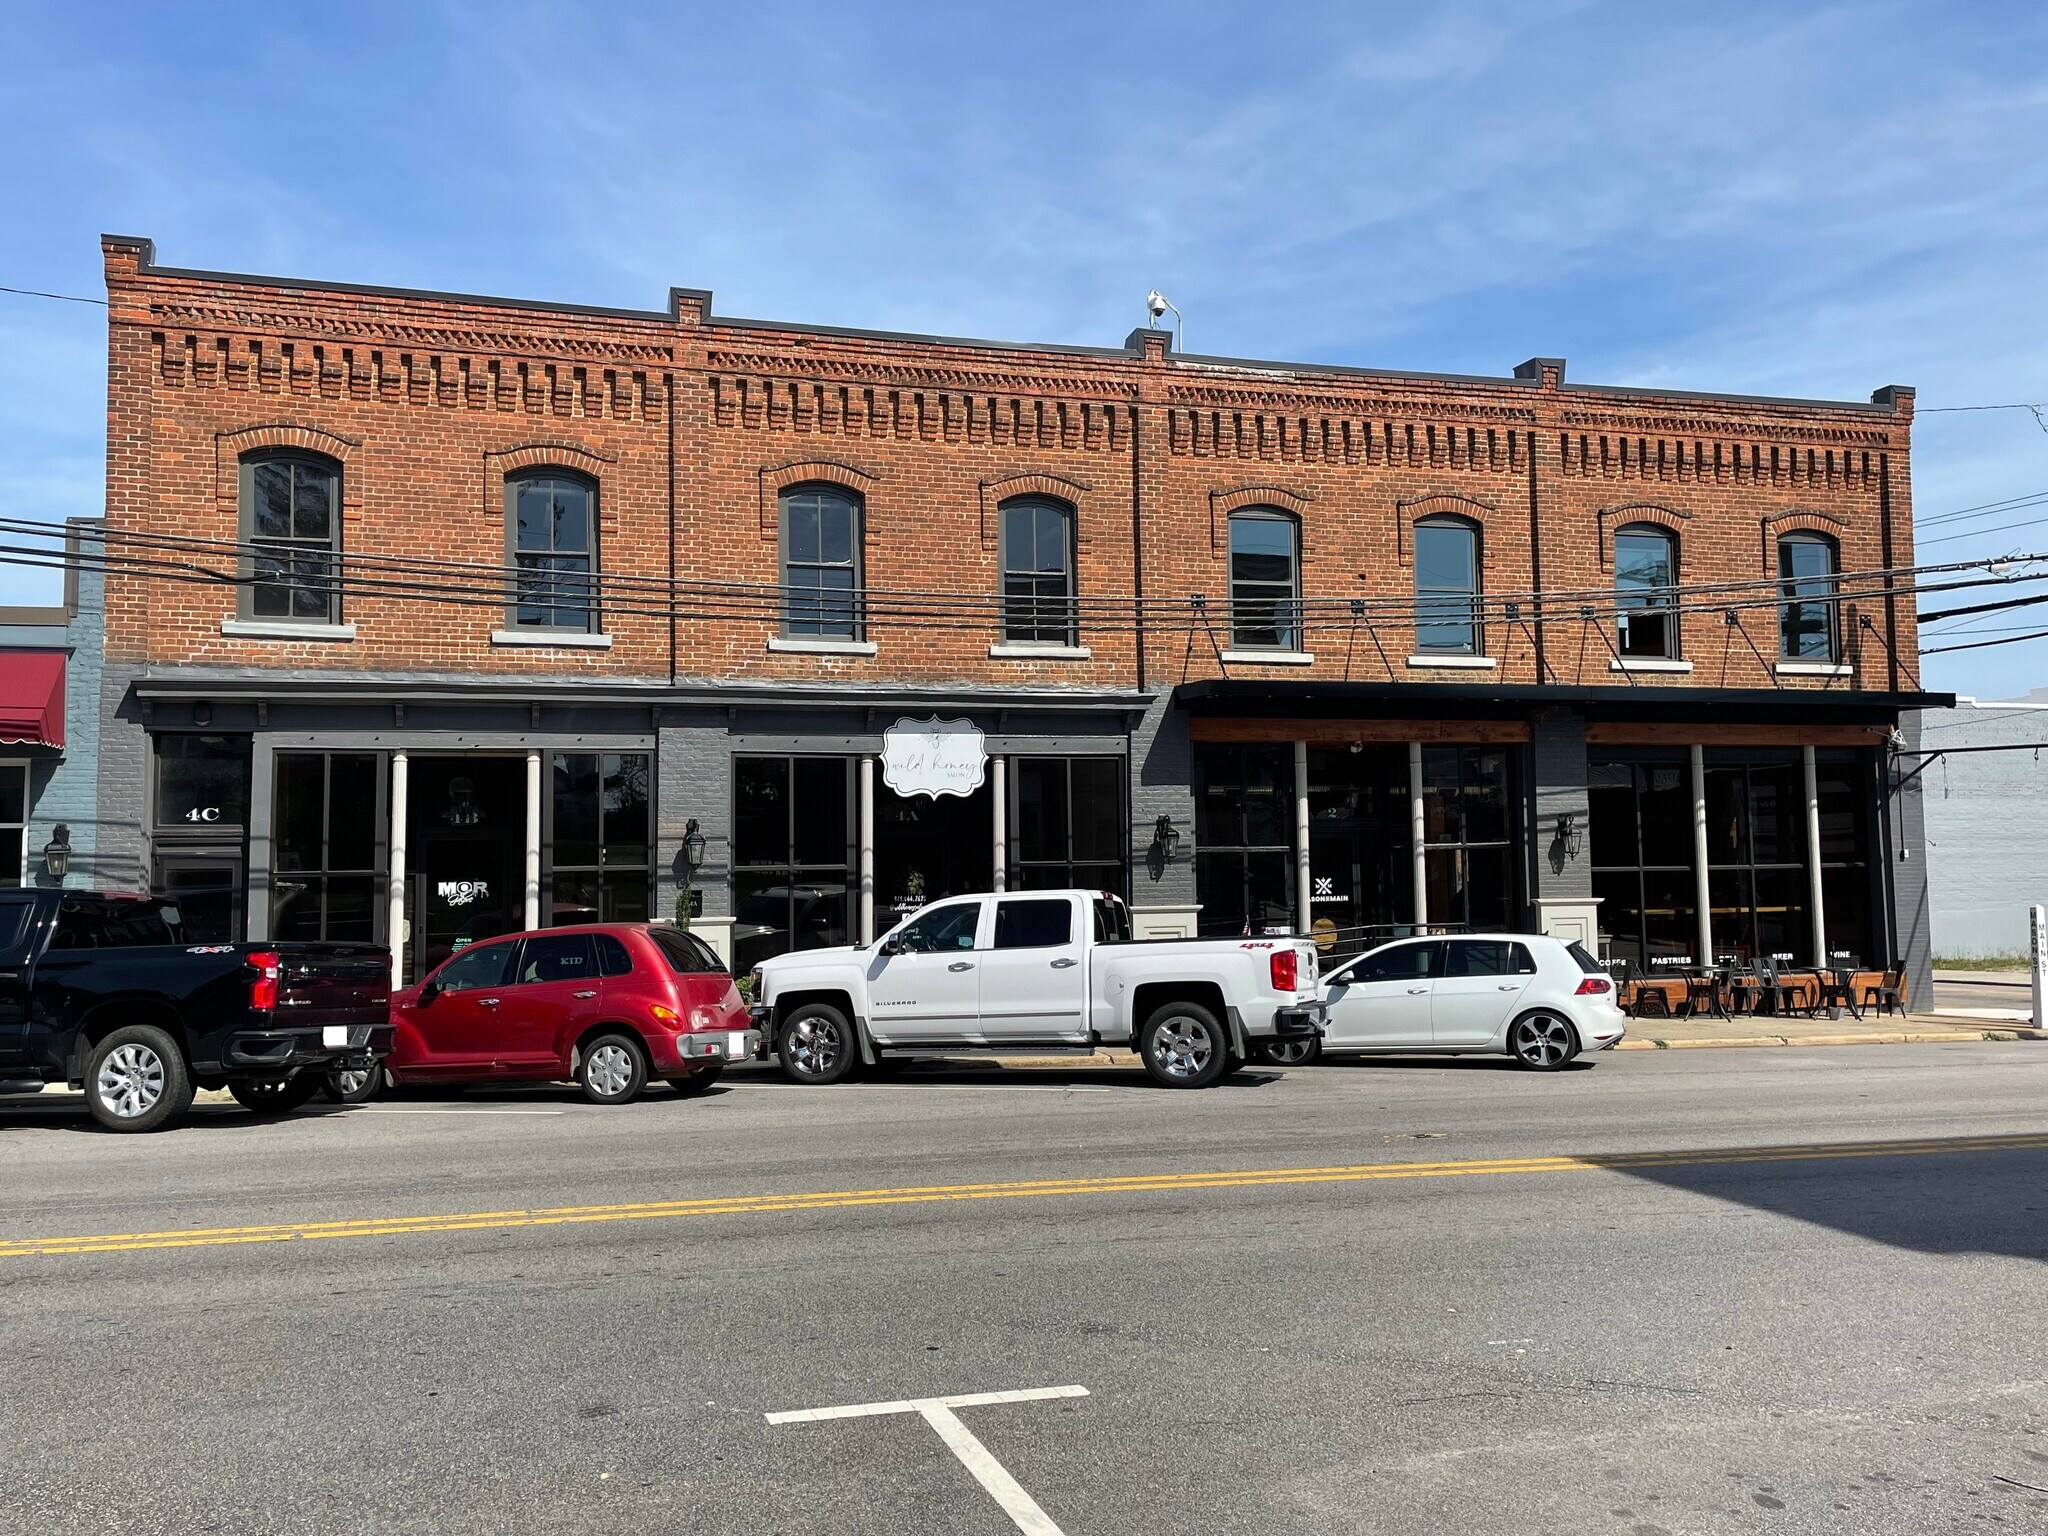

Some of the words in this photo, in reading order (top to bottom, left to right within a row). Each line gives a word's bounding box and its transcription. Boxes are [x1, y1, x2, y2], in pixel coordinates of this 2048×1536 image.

[892, 754, 925, 775] wild
[932, 753, 978, 780] honey
[185, 807, 220, 821] 4C
[1327, 807, 1337, 819] 2
[437, 881, 489, 899] MOR
[2030, 911, 2038, 954] MASON
[560, 957, 583, 965] KID
[1651, 957, 1692, 965] PASTRIES
[2033, 957, 2038, 973] ST
[2041, 961, 2047, 977] ST
